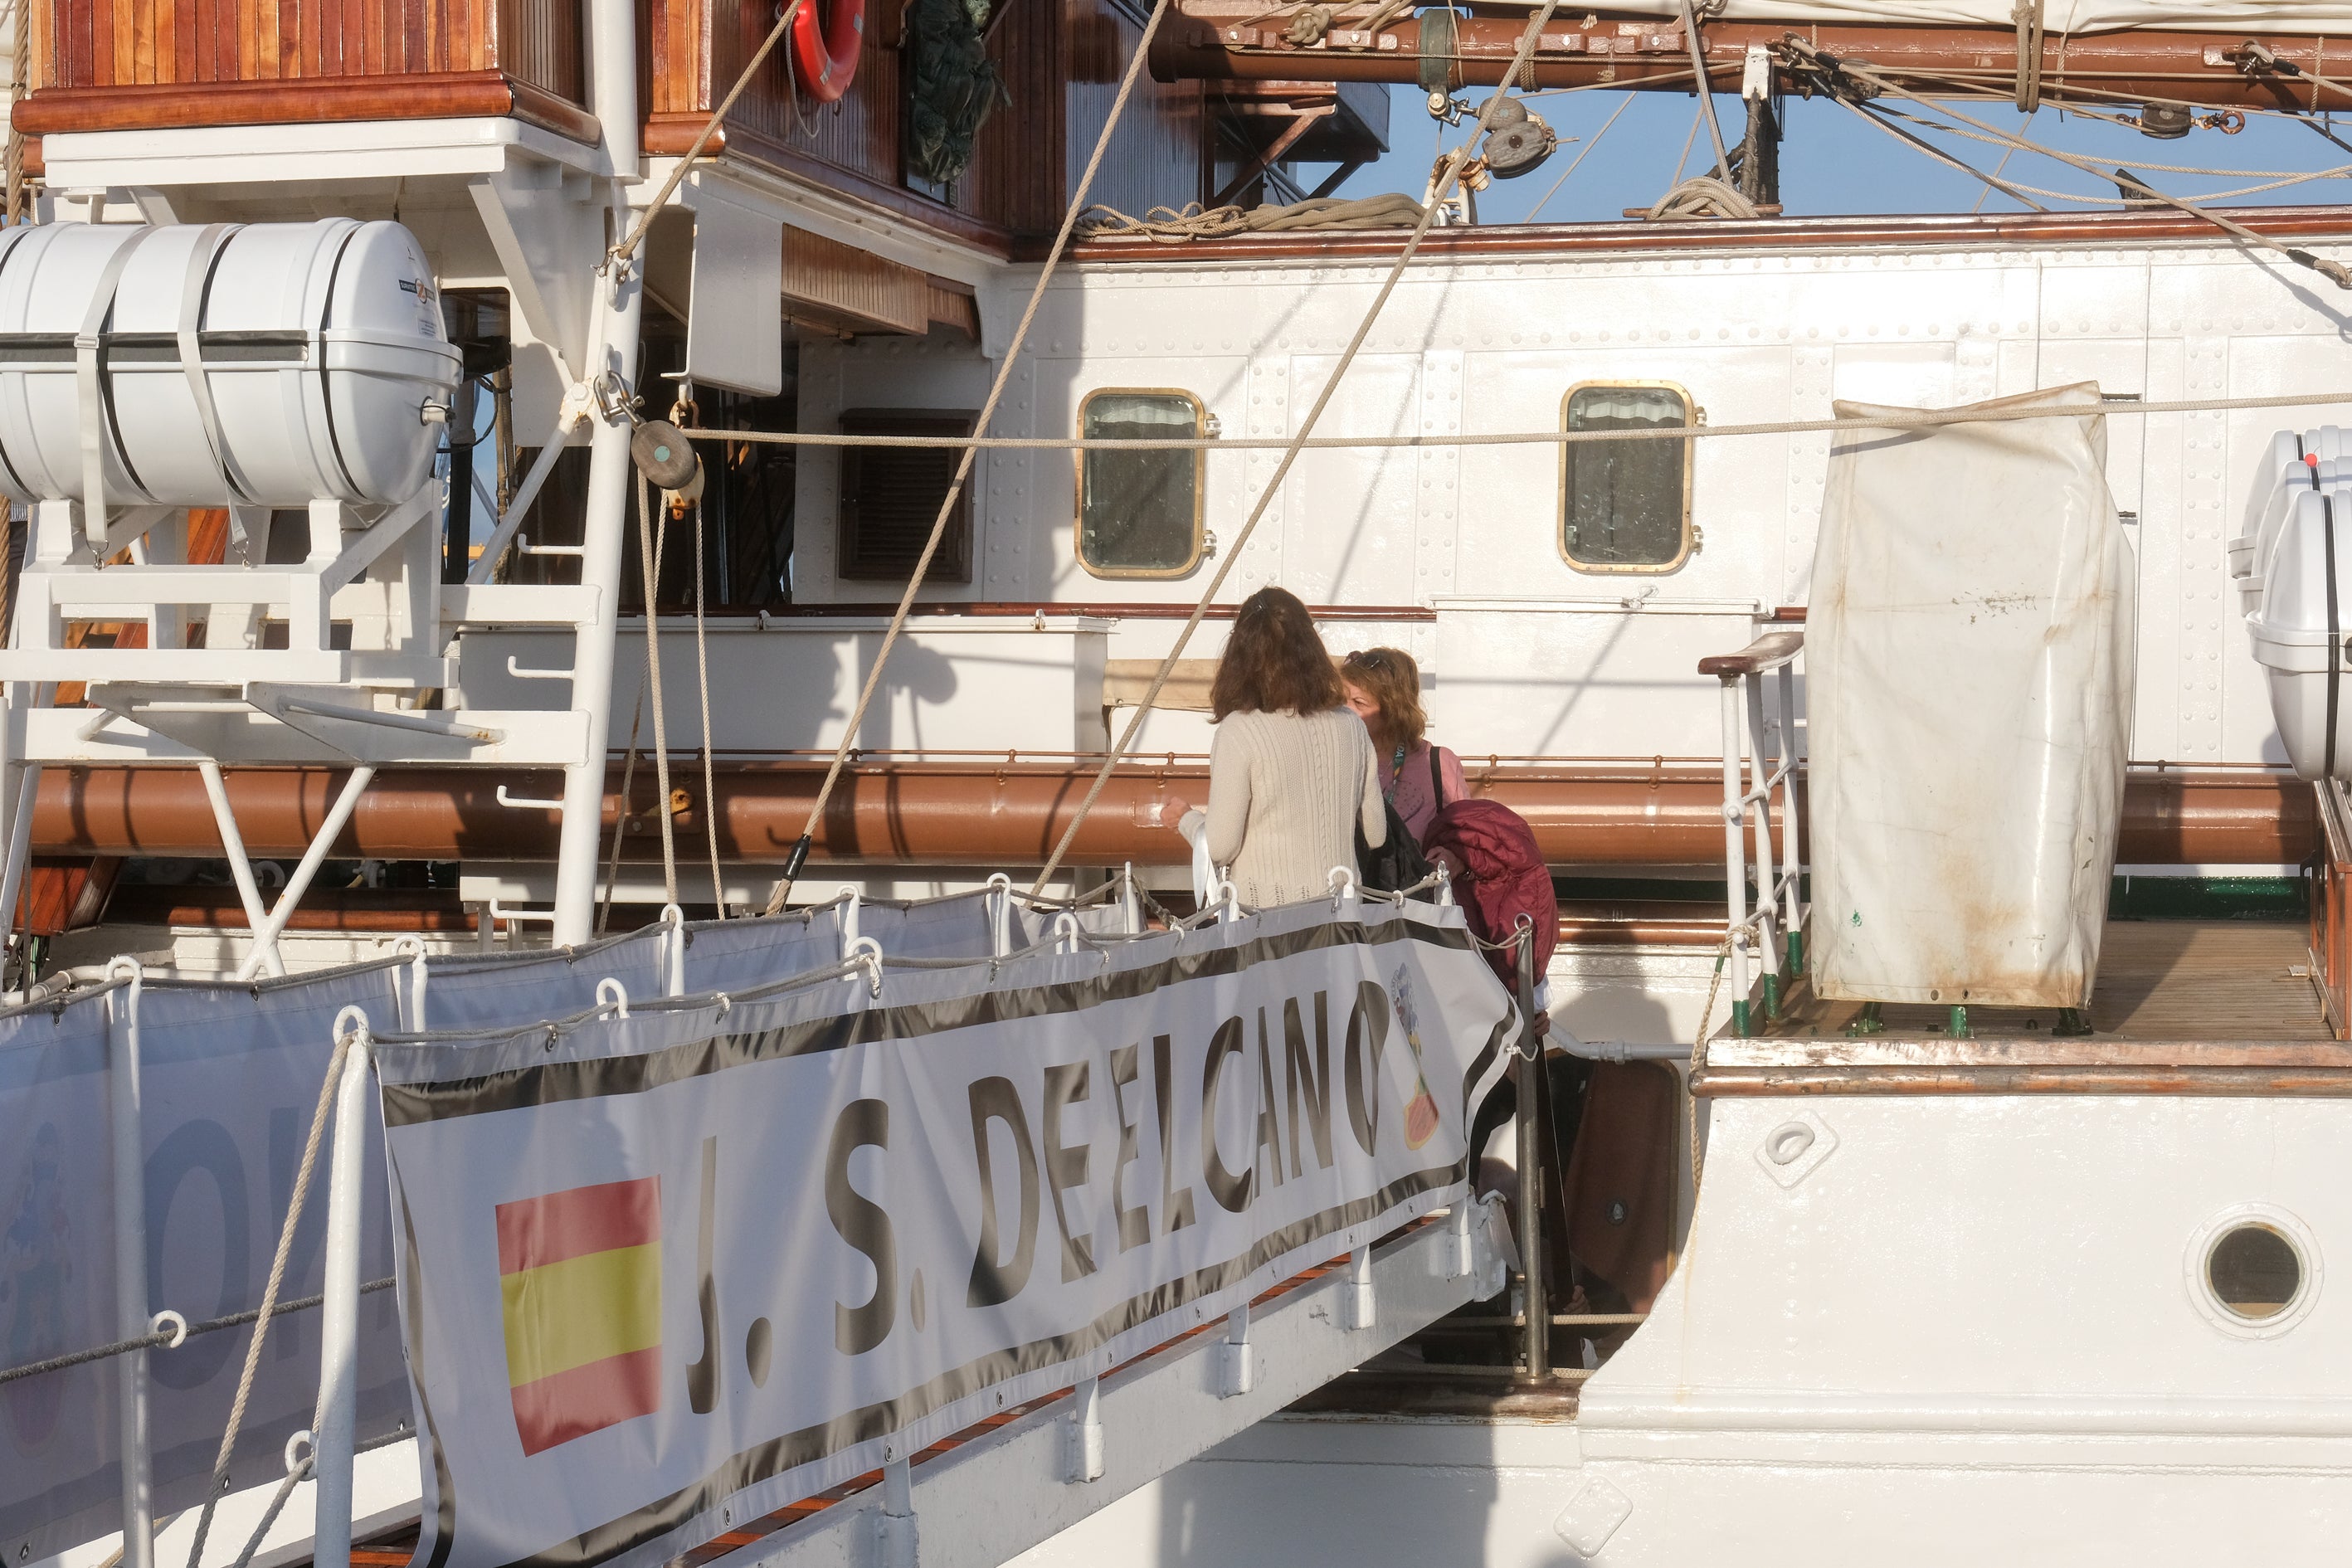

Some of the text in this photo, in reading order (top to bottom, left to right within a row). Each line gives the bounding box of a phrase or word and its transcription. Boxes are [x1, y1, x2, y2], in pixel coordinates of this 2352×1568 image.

[685, 1134, 772, 1415] J.
[825, 1098, 926, 1356] S.
[967, 1059, 1098, 1308] DE
[1110, 980, 1390, 1254] ELCANO
